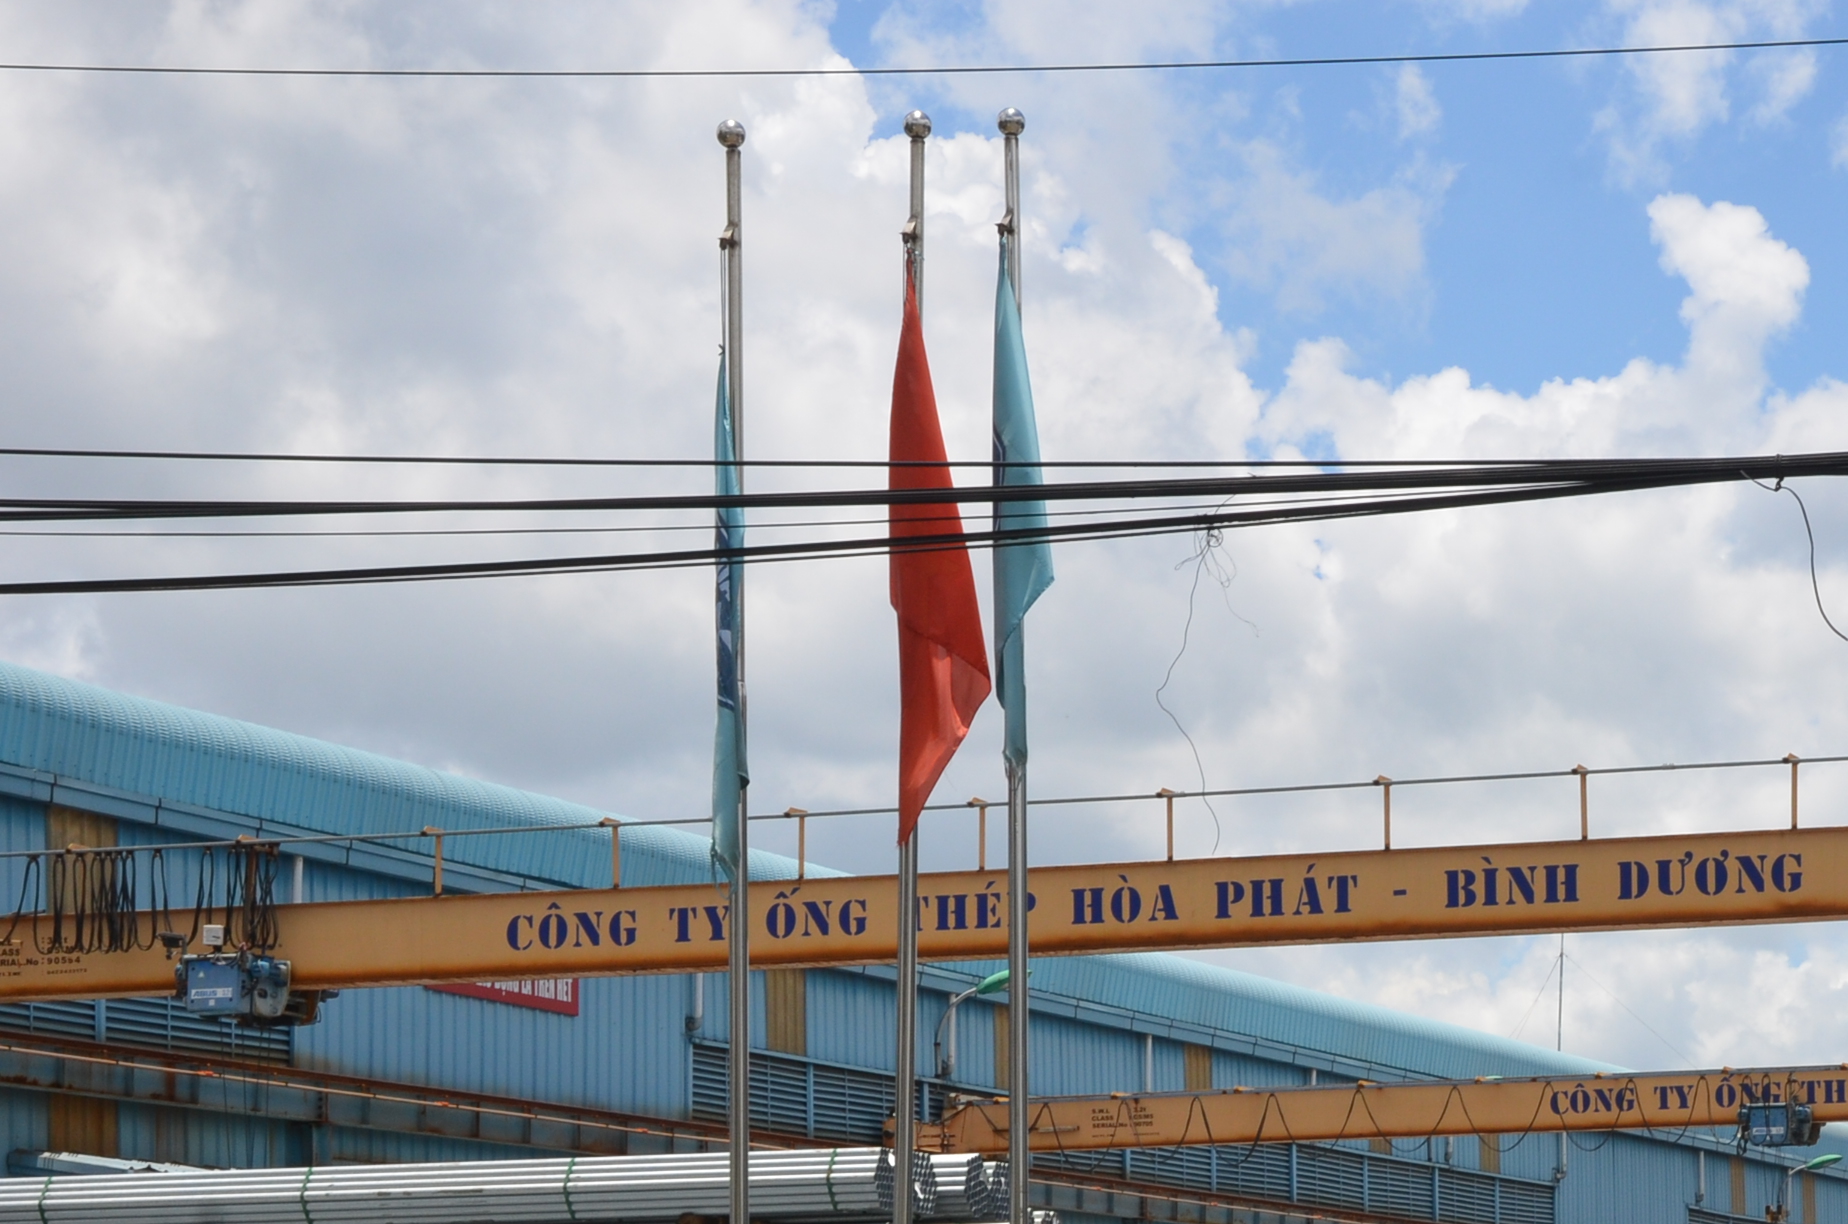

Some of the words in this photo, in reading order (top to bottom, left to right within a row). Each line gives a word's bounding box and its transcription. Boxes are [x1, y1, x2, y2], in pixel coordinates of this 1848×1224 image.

[506, 902, 637, 952] CÔNG
[669, 905, 730, 943] TY
[766, 887, 868, 939] ỐNG
[1071, 874, 1179, 924] HÒA
[1215, 863, 1358, 919] PHÁT
[1445, 857, 1580, 908] BÌNH
[1617, 849, 1803, 900] DƯƠNG
[1550, 1083, 1636, 1116] CÔNG
[1653, 1085, 1694, 1110] TY
[1715, 1073, 1781, 1108] ỐNG
